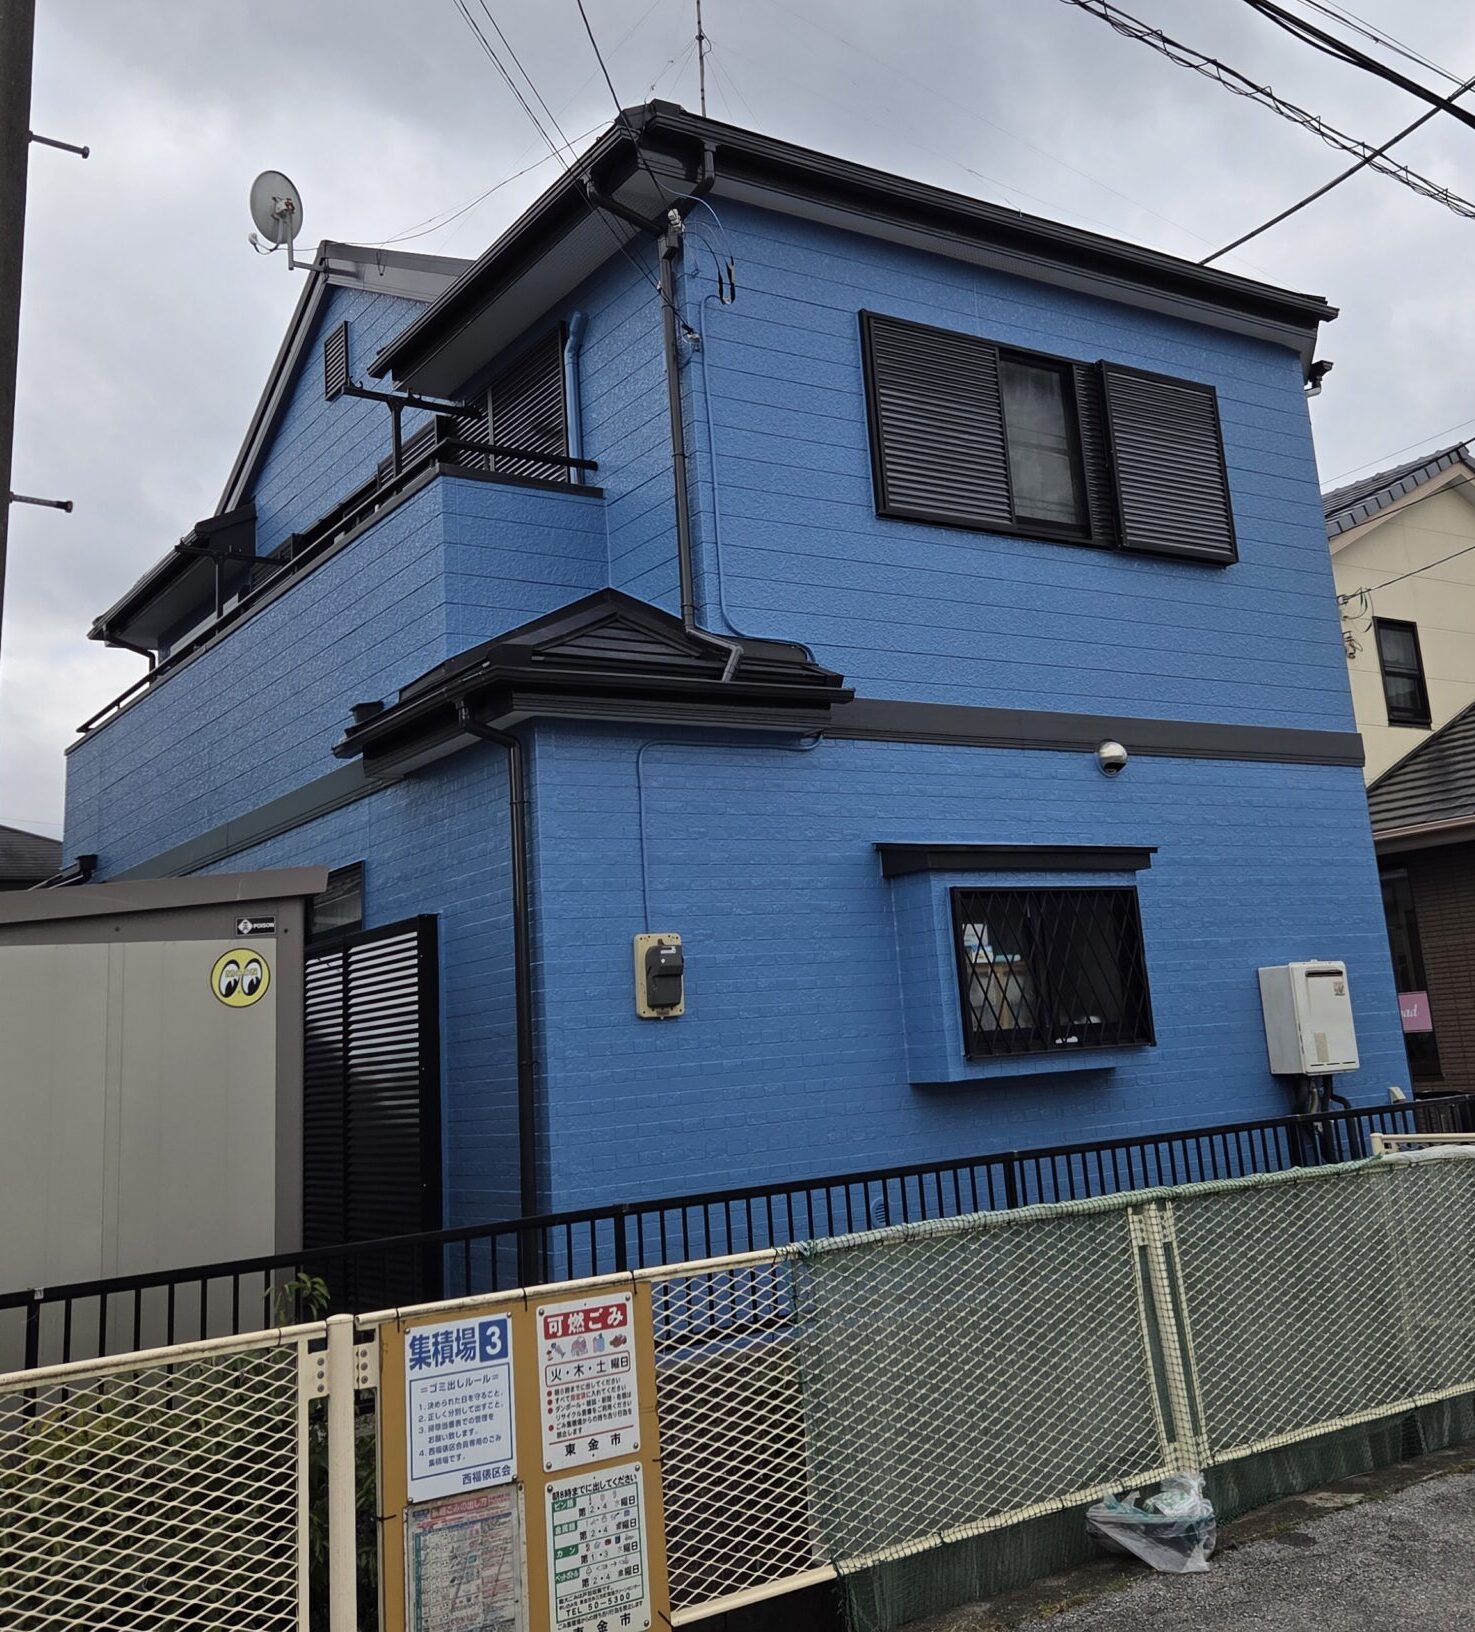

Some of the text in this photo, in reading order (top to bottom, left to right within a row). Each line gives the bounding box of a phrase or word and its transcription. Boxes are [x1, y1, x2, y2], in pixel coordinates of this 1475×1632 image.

[547, 1306, 623, 1336] 可燃ごみ
[409, 1325, 502, 1371] 集積場 3
[565, 1433, 621, 1456] 東金市
[566, 1606, 582, 1617] TEL
